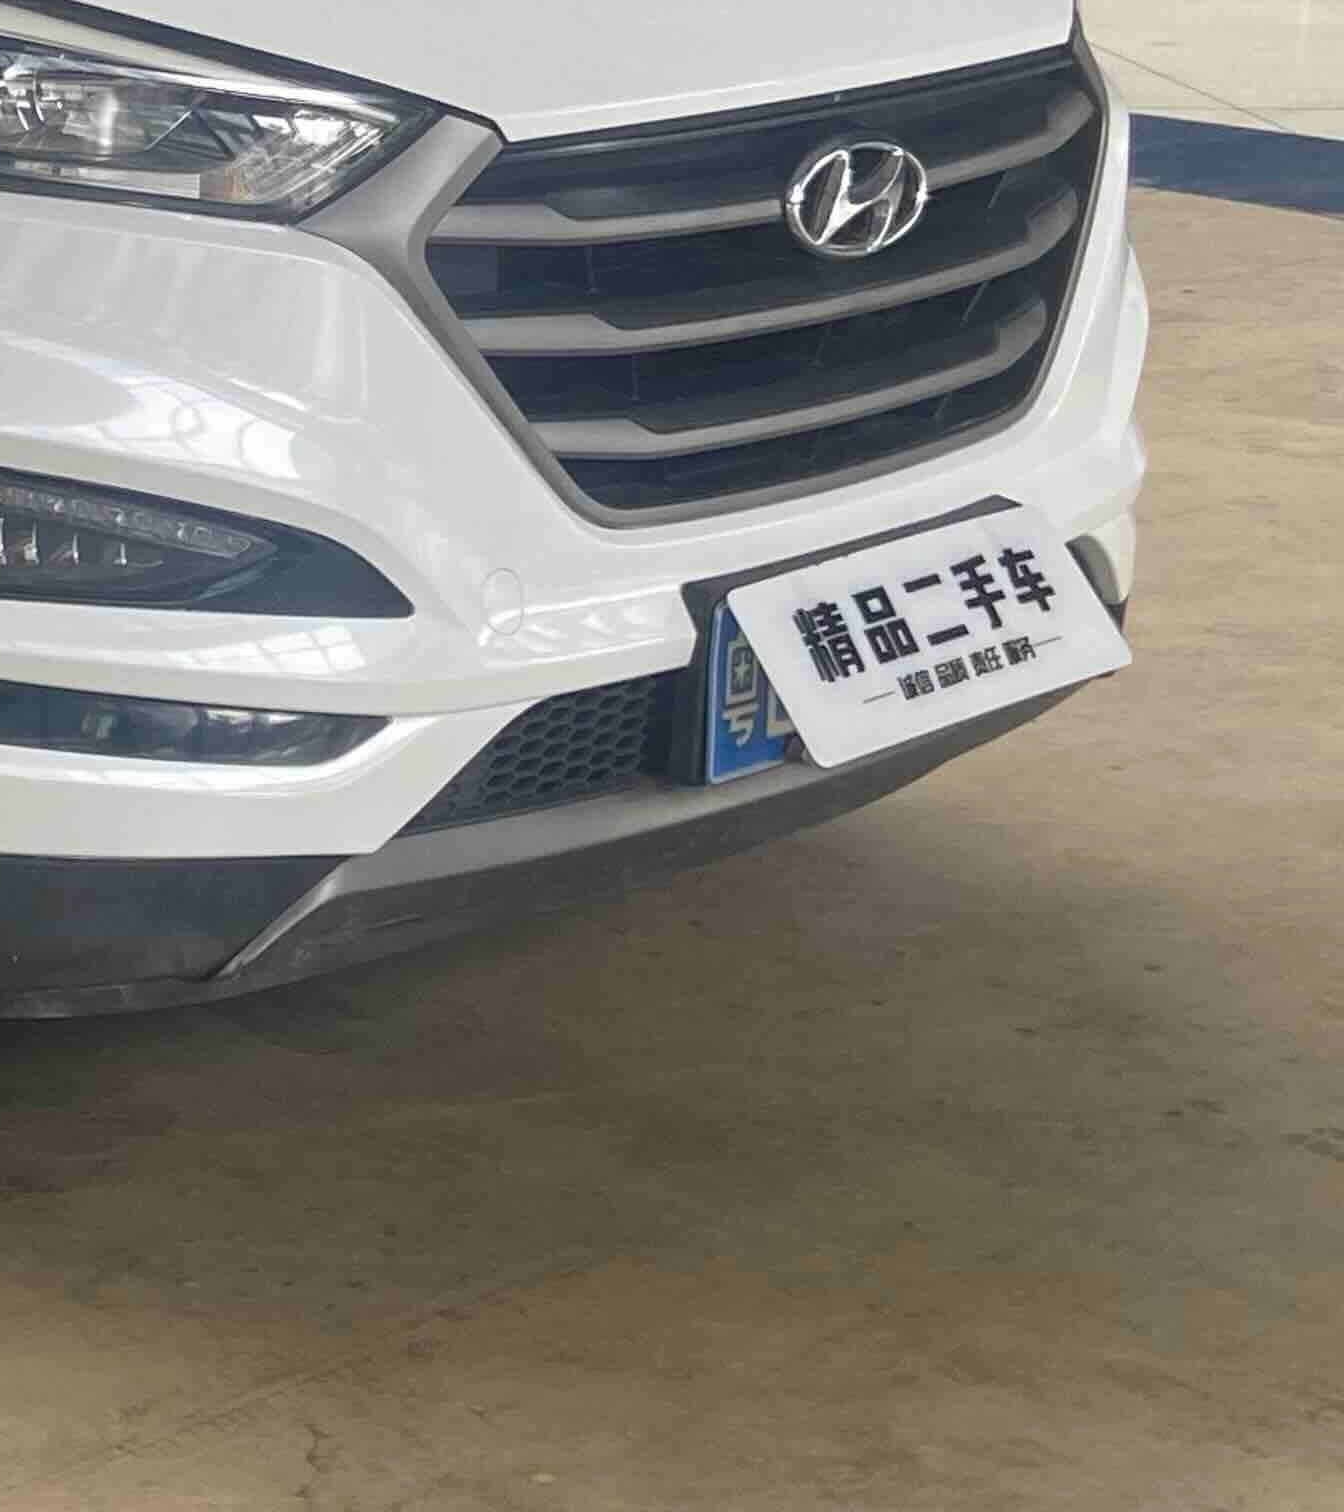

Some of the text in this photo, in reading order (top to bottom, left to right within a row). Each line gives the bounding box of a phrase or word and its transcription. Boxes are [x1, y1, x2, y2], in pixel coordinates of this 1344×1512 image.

[792, 548, 1056, 683] 精品二手车
